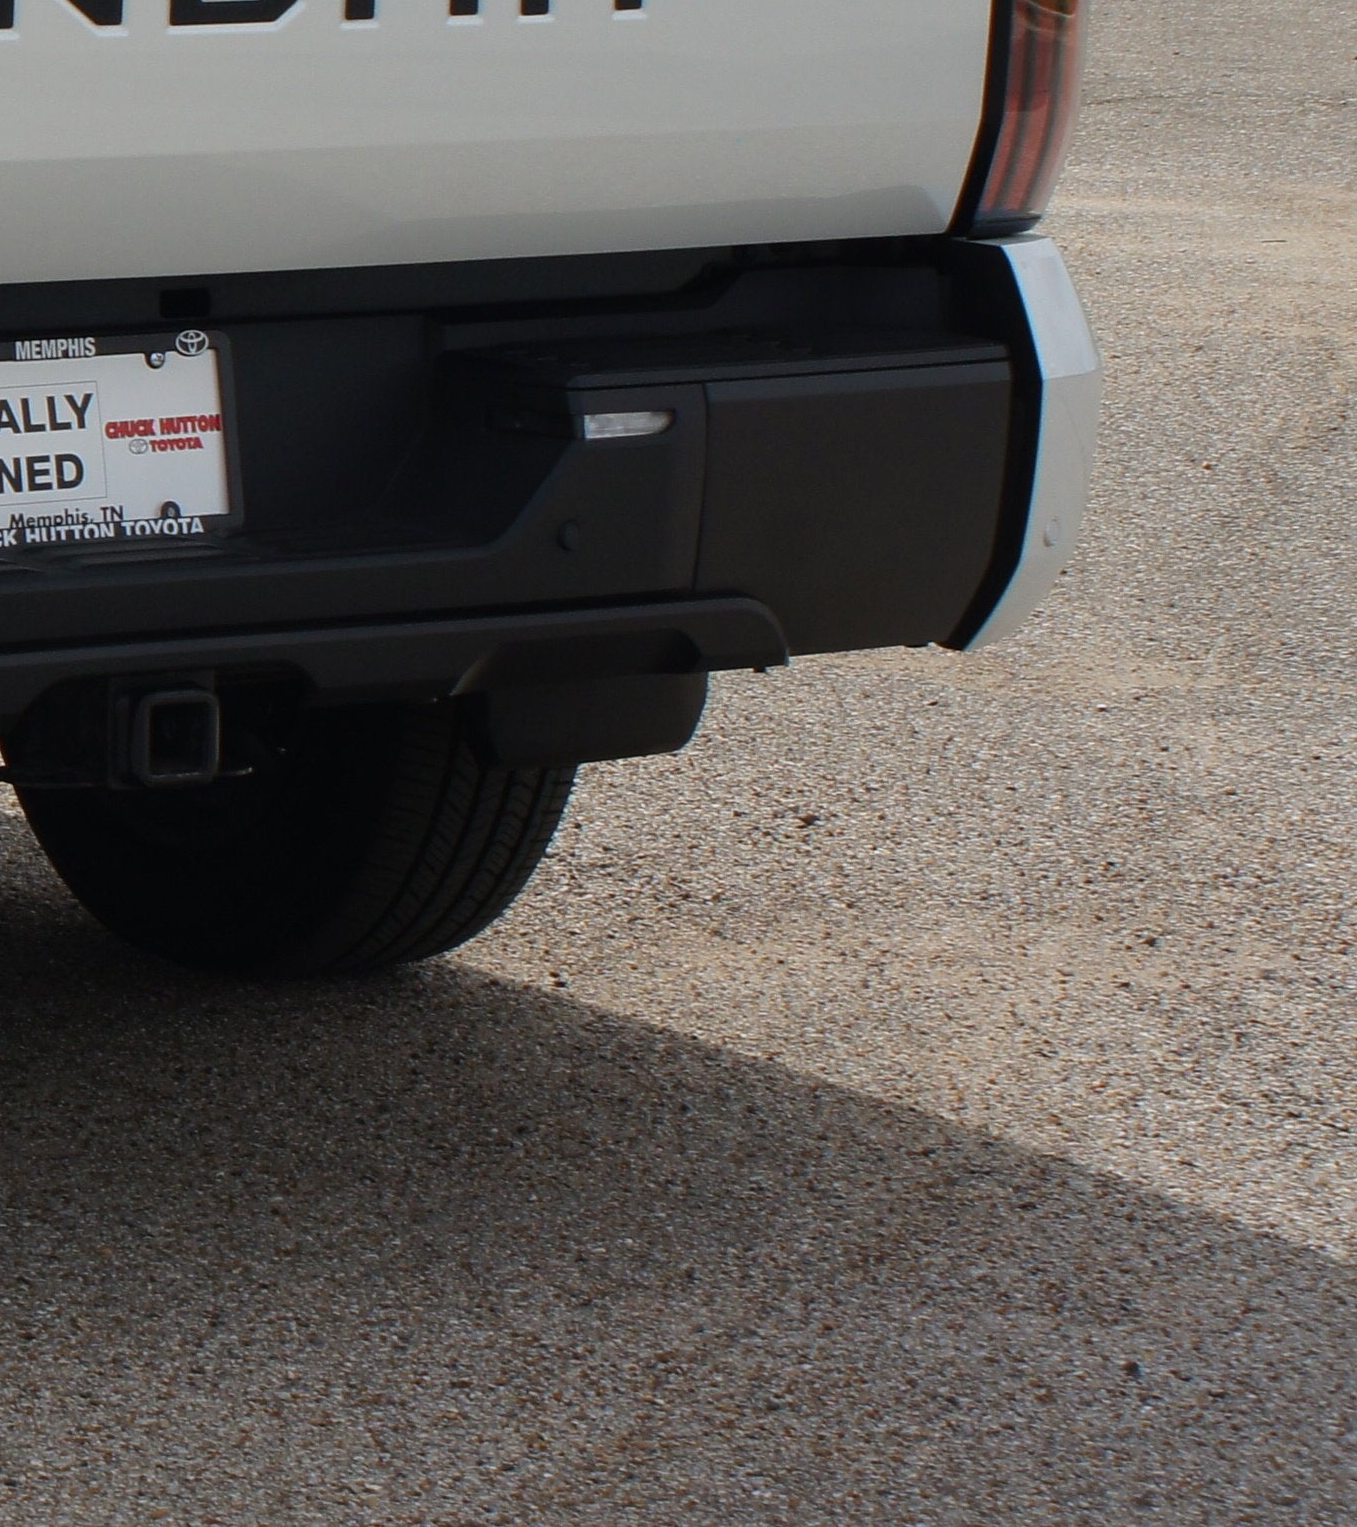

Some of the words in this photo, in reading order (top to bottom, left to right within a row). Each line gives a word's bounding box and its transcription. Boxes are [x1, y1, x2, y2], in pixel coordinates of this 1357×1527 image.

[14, 337, 97, 361] MEMPHIS
[104, 418, 156, 440] CHUCK
[159, 413, 223, 436] HUTTON
[149, 436, 205, 453] TOYOTA
[100, 505, 125, 522] TN
[25, 522, 115, 545] HUTTON
[121, 516, 205, 537] TOYOTA
